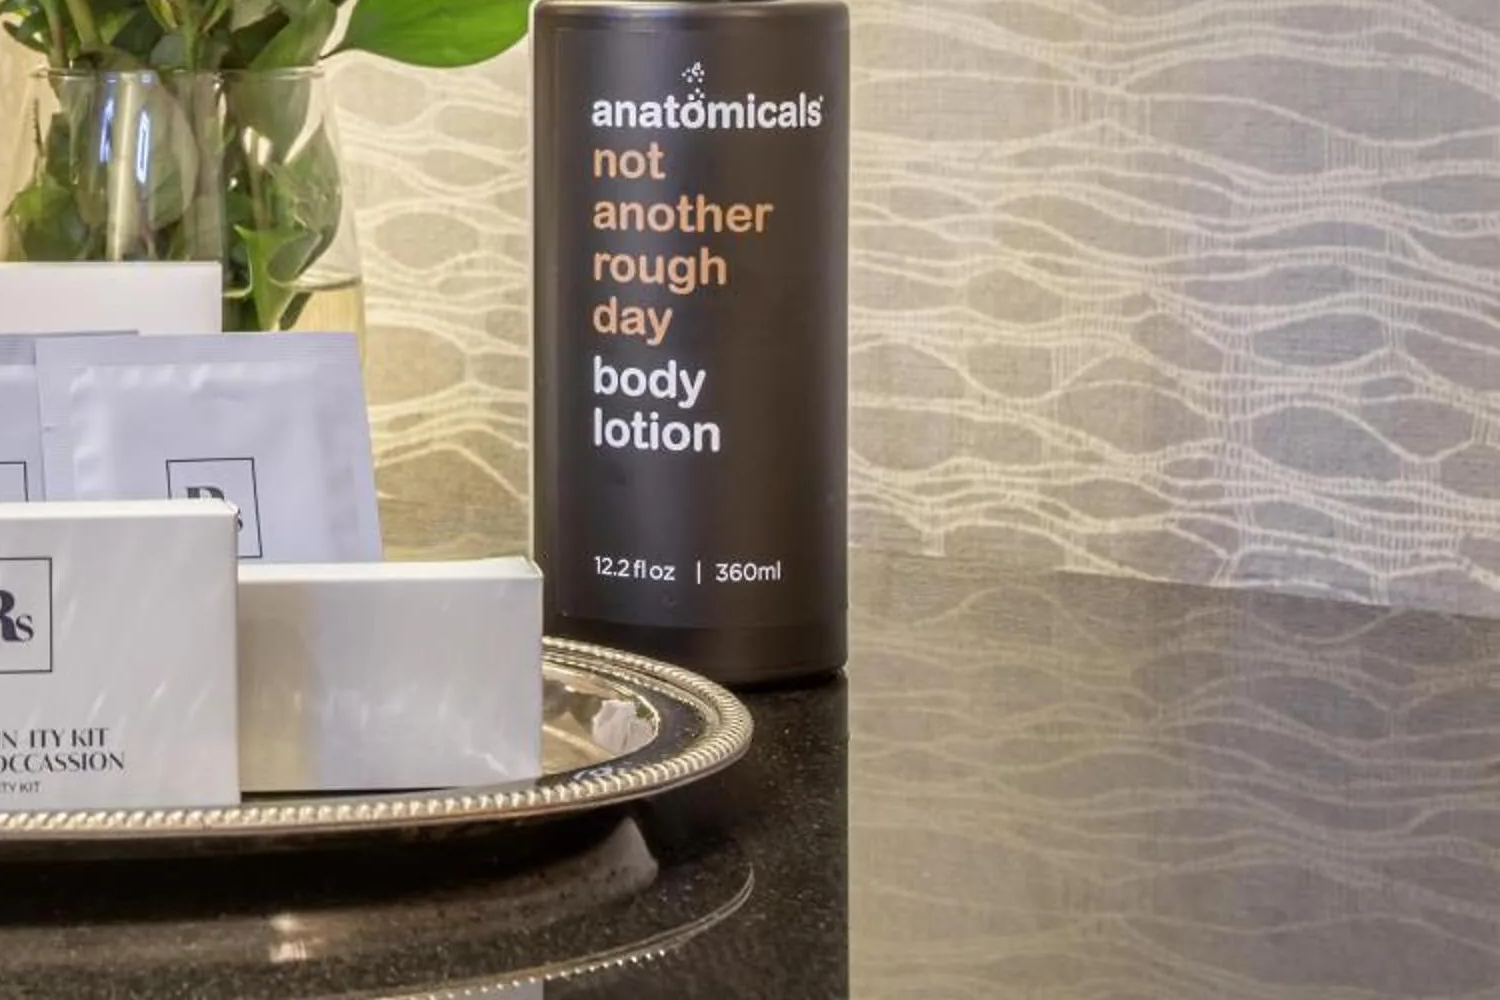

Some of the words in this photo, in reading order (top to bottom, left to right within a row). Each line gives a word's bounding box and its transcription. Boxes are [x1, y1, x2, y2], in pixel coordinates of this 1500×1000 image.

[593, 141, 666, 180] not
[593, 194, 773, 233] another
[593, 247, 727, 295] rough
[593, 296, 674, 346] day
[594, 355, 706, 409] body
[594, 408, 721, 452] lotion
[715, 560, 782, 582] 360ml
[71, 727, 110, 748] KIT
[19, 781, 41, 793] KIT
